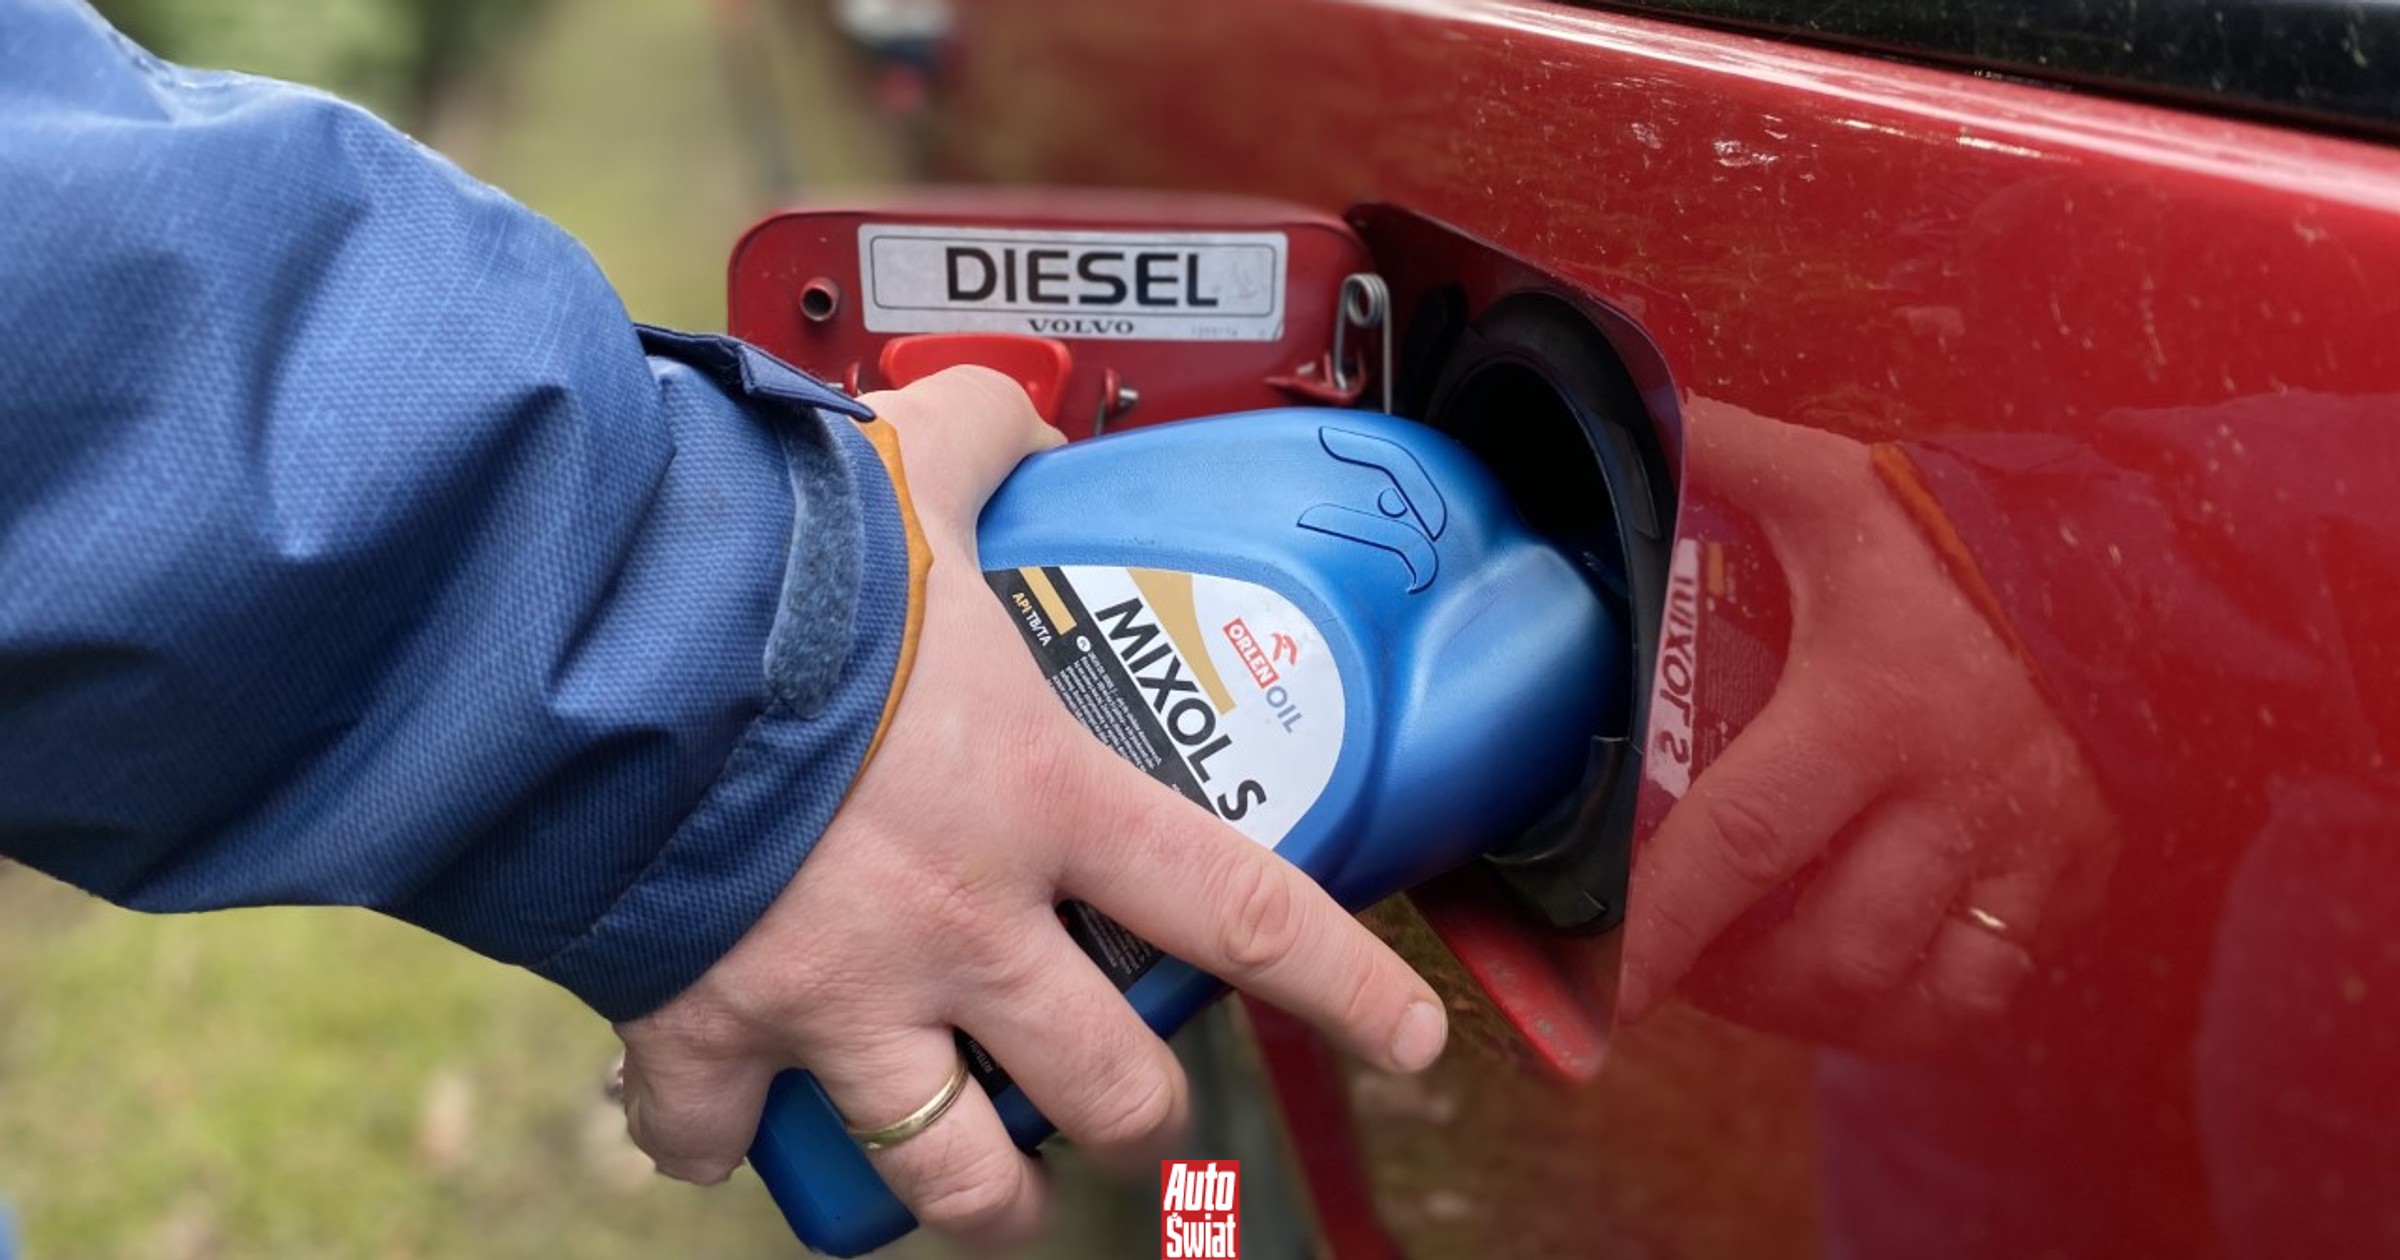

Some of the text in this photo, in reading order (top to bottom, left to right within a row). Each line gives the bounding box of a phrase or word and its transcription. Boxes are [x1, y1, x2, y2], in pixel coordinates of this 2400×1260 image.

[945, 246, 1218, 307] DIESEL
[1027, 318, 1134, 335] VOLVO
[1011, 592, 1053, 647] API TB/TA
[1228, 621, 1275, 685] ORLEN
[1095, 597, 1232, 783] MIXOL
[1216, 779, 1267, 821] S
[1265, 686, 1305, 734] OIL
